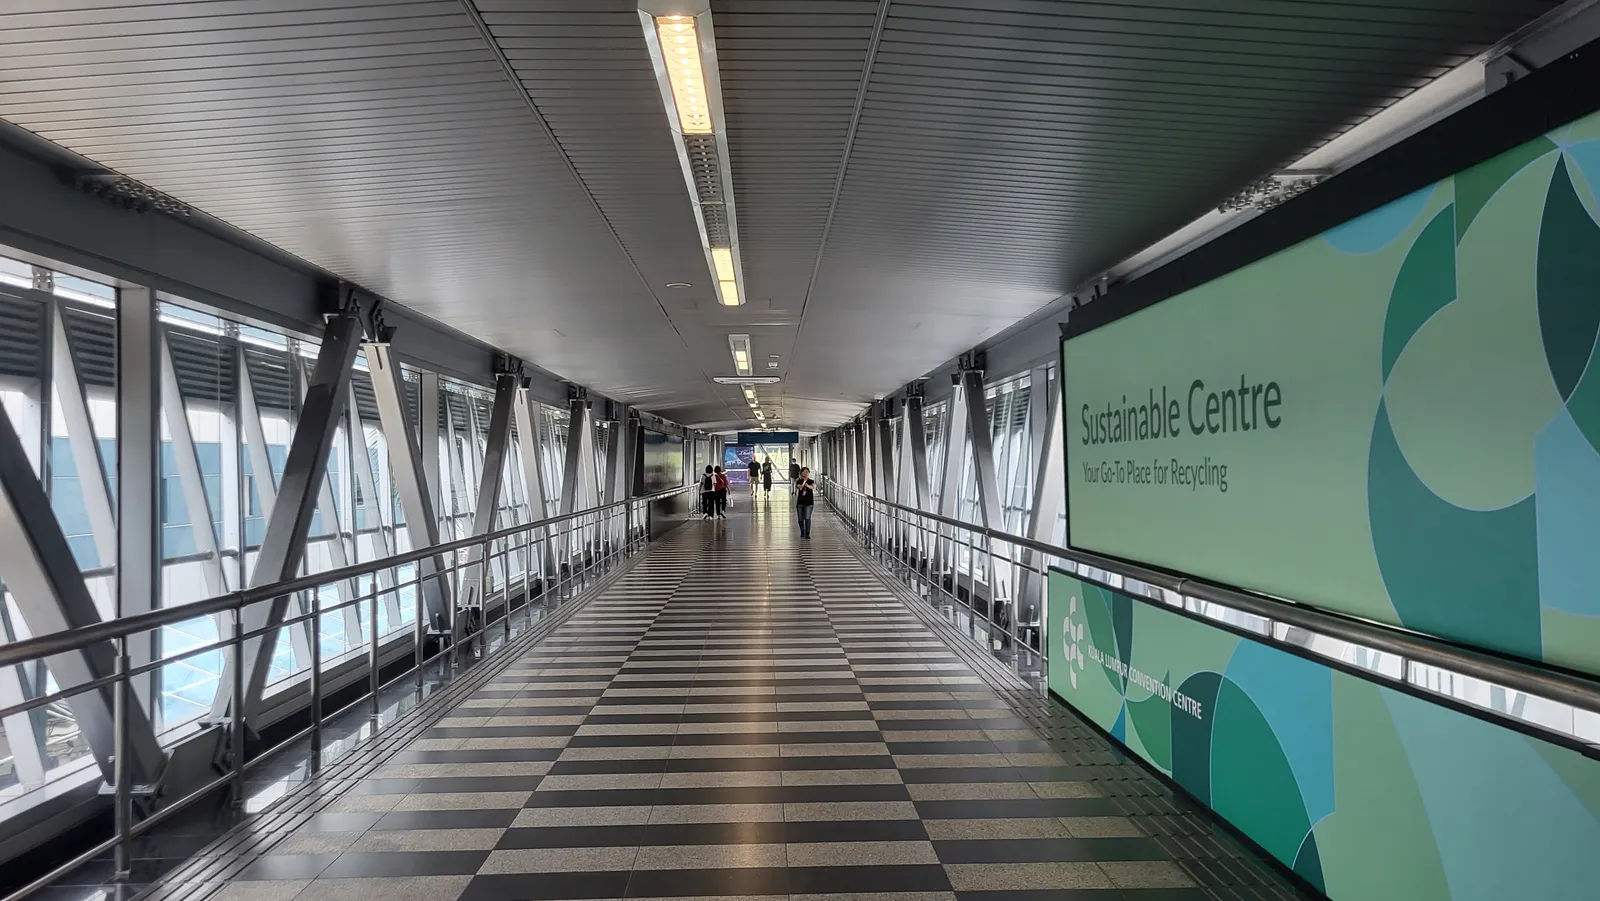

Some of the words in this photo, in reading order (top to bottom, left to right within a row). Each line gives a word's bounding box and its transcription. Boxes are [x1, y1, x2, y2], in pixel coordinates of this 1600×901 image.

[1082, 386, 1180, 445] Sustainable
[1188, 373, 1282, 436] Centre
[1083, 462, 1100, 483] Your
[1101, 461, 1125, 484] Go-To
[1127, 460, 1151, 484] Place
[1153, 459, 1168, 485] for
[1171, 457, 1228, 493] Recycling
[1088, 645, 1105, 666] KUALA
[1105, 654, 1128, 677] LUMPUR
[1129, 667, 1171, 703] CONVENTION
[1172, 690, 1202, 720] CENTRE
